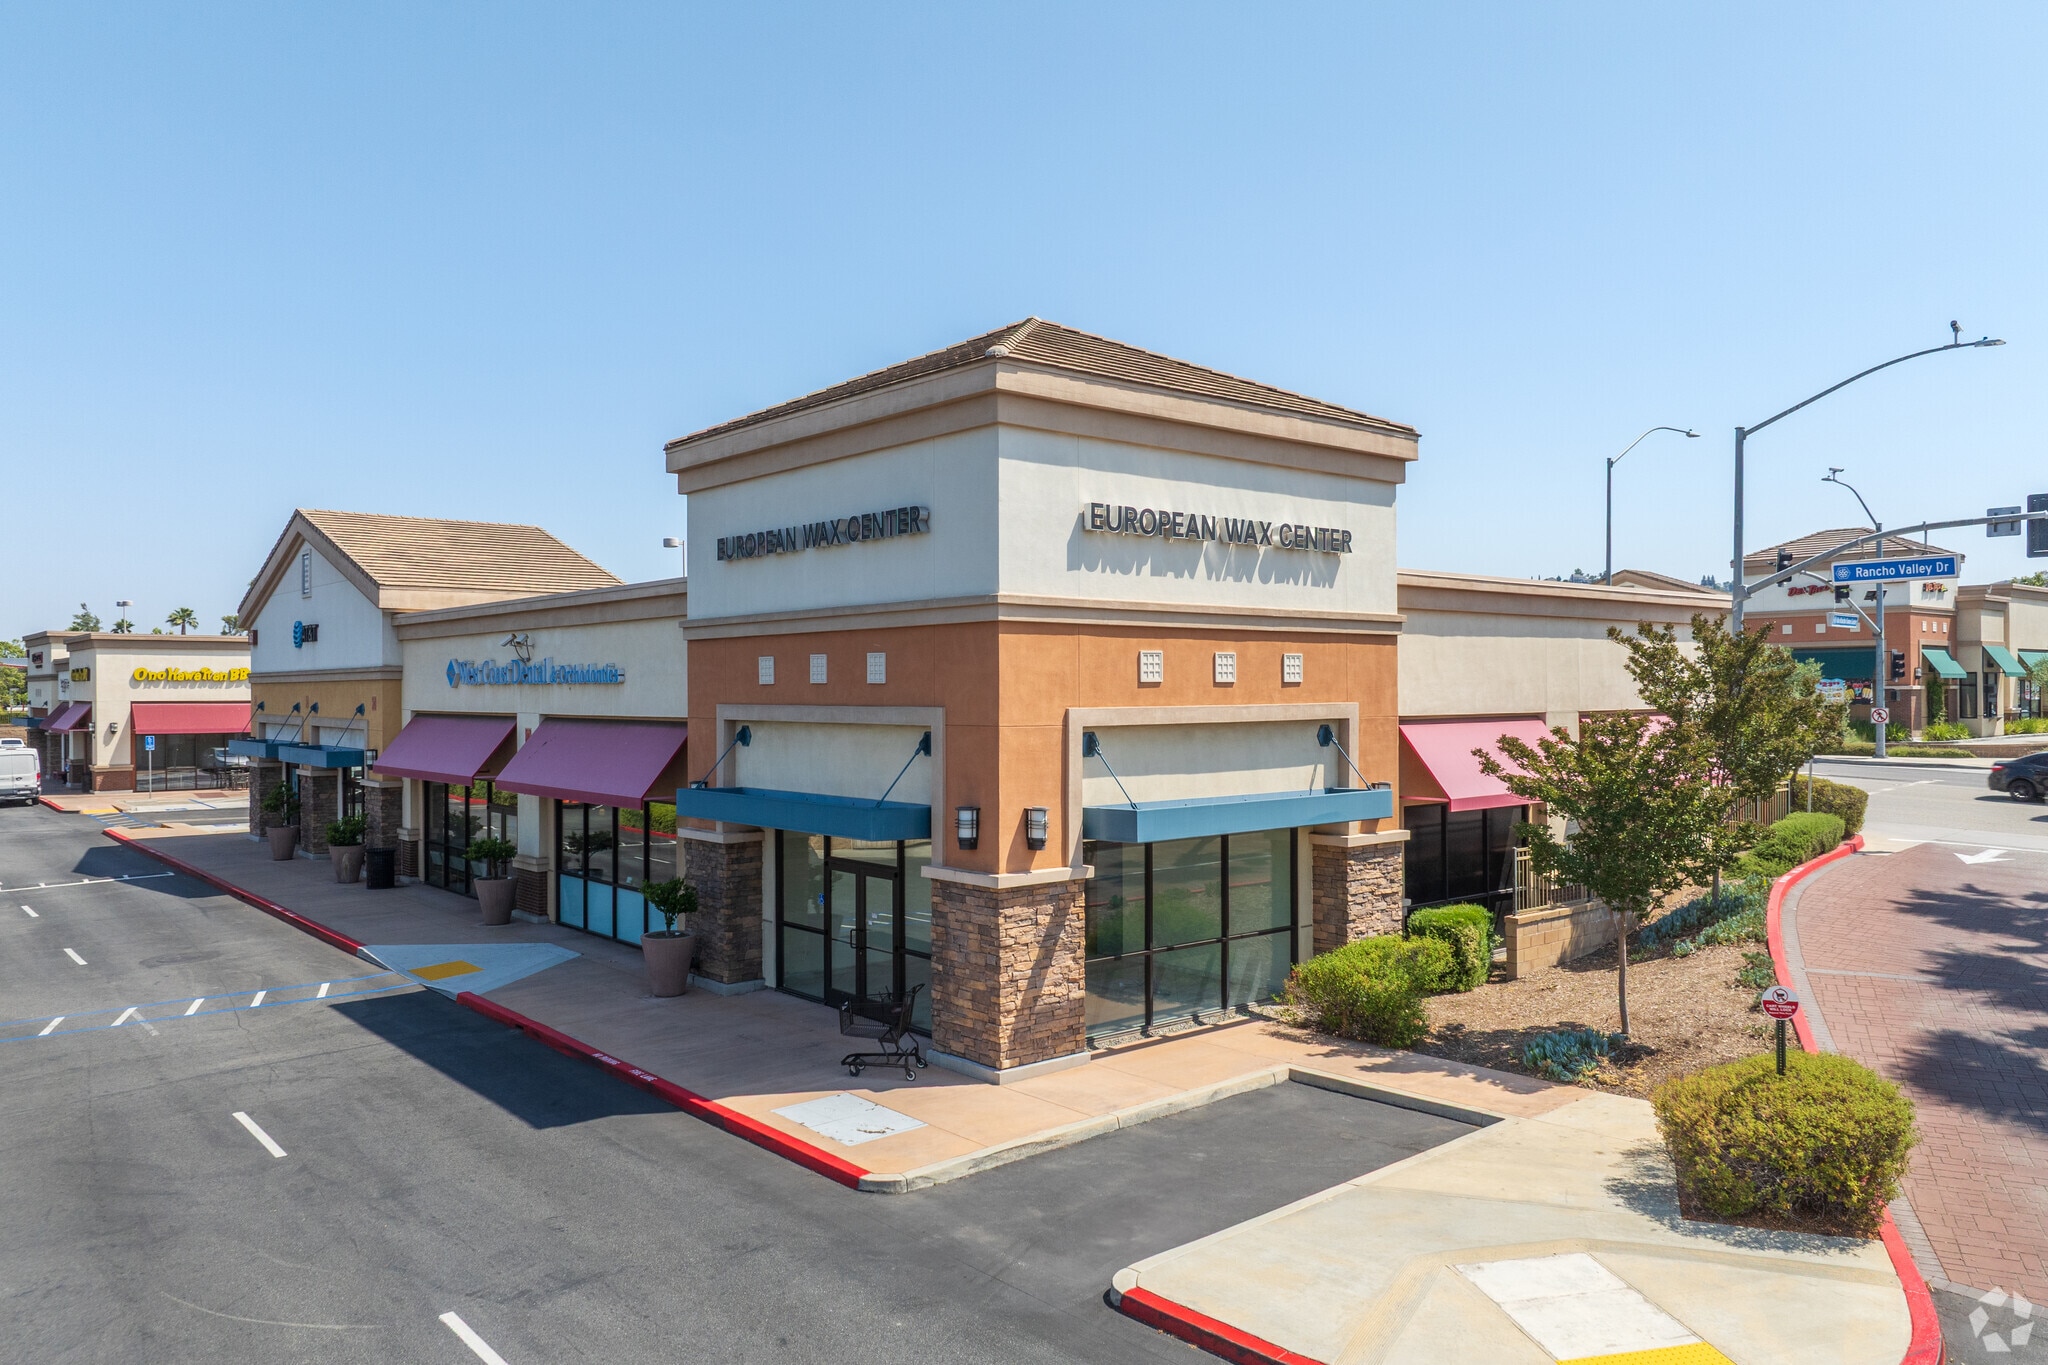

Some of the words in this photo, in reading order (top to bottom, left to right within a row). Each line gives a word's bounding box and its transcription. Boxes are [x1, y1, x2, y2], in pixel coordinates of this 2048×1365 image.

[716, 526, 797, 561] EUROPEAN
[802, 518, 842, 549] WAX
[846, 505, 925, 543] CENTER
[1086, 502, 1216, 541] EUROPEAN
[1224, 517, 1272, 546] WAX
[1279, 522, 1353, 554] CENTER
[1855, 565, 1896, 578] Rancho
[1898, 563, 1933, 576] Valley
[1936, 561, 1950, 573] Dr
[133, 666, 167, 682] Ono
[229, 666, 251, 682] BB
[458, 661, 480, 685] West
[482, 660, 510, 685] Coast
[511, 657, 551, 685] Dental
[550, 670, 557, 684] &
[559, 662, 619, 685] Orthodontics
